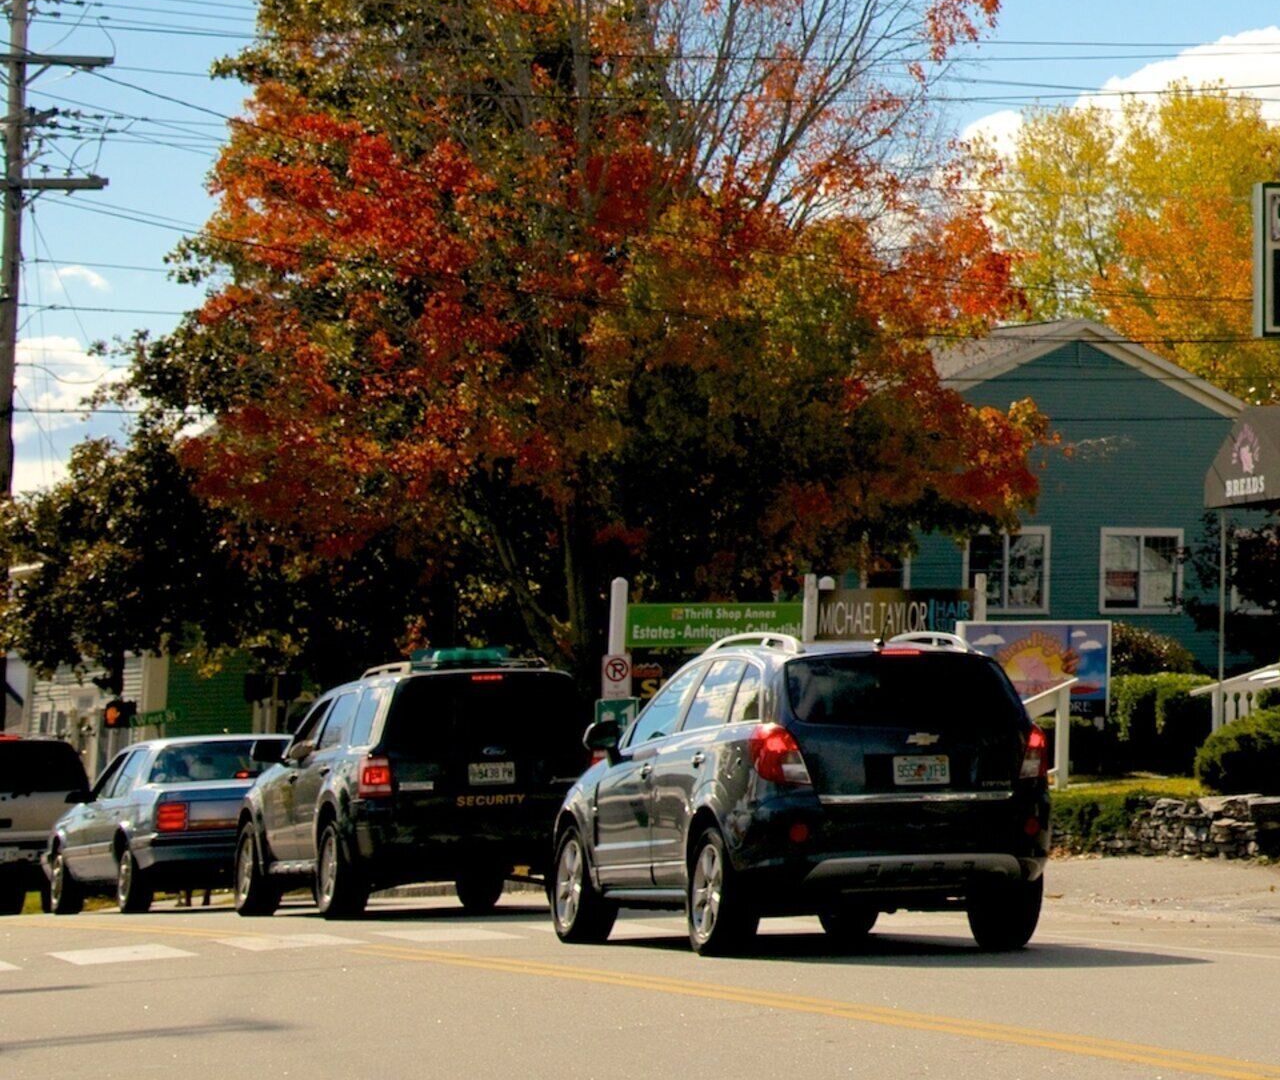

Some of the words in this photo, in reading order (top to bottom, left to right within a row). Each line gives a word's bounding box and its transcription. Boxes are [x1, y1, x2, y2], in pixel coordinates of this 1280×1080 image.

[1225, 475, 1265, 498] BREADS
[684, 607, 713, 619] Thrift
[716, 607, 742, 621] Shop
[745, 607, 777, 619] Annex
[935, 600, 970, 618] HAIR
[819, 601, 876, 635] MICHAEL
[879, 601, 928, 634] TAYLOR
[632, 624, 676, 640] Estates
[683, 623, 737, 639] Antiques
[456, 793, 526, 808] SECURITY
